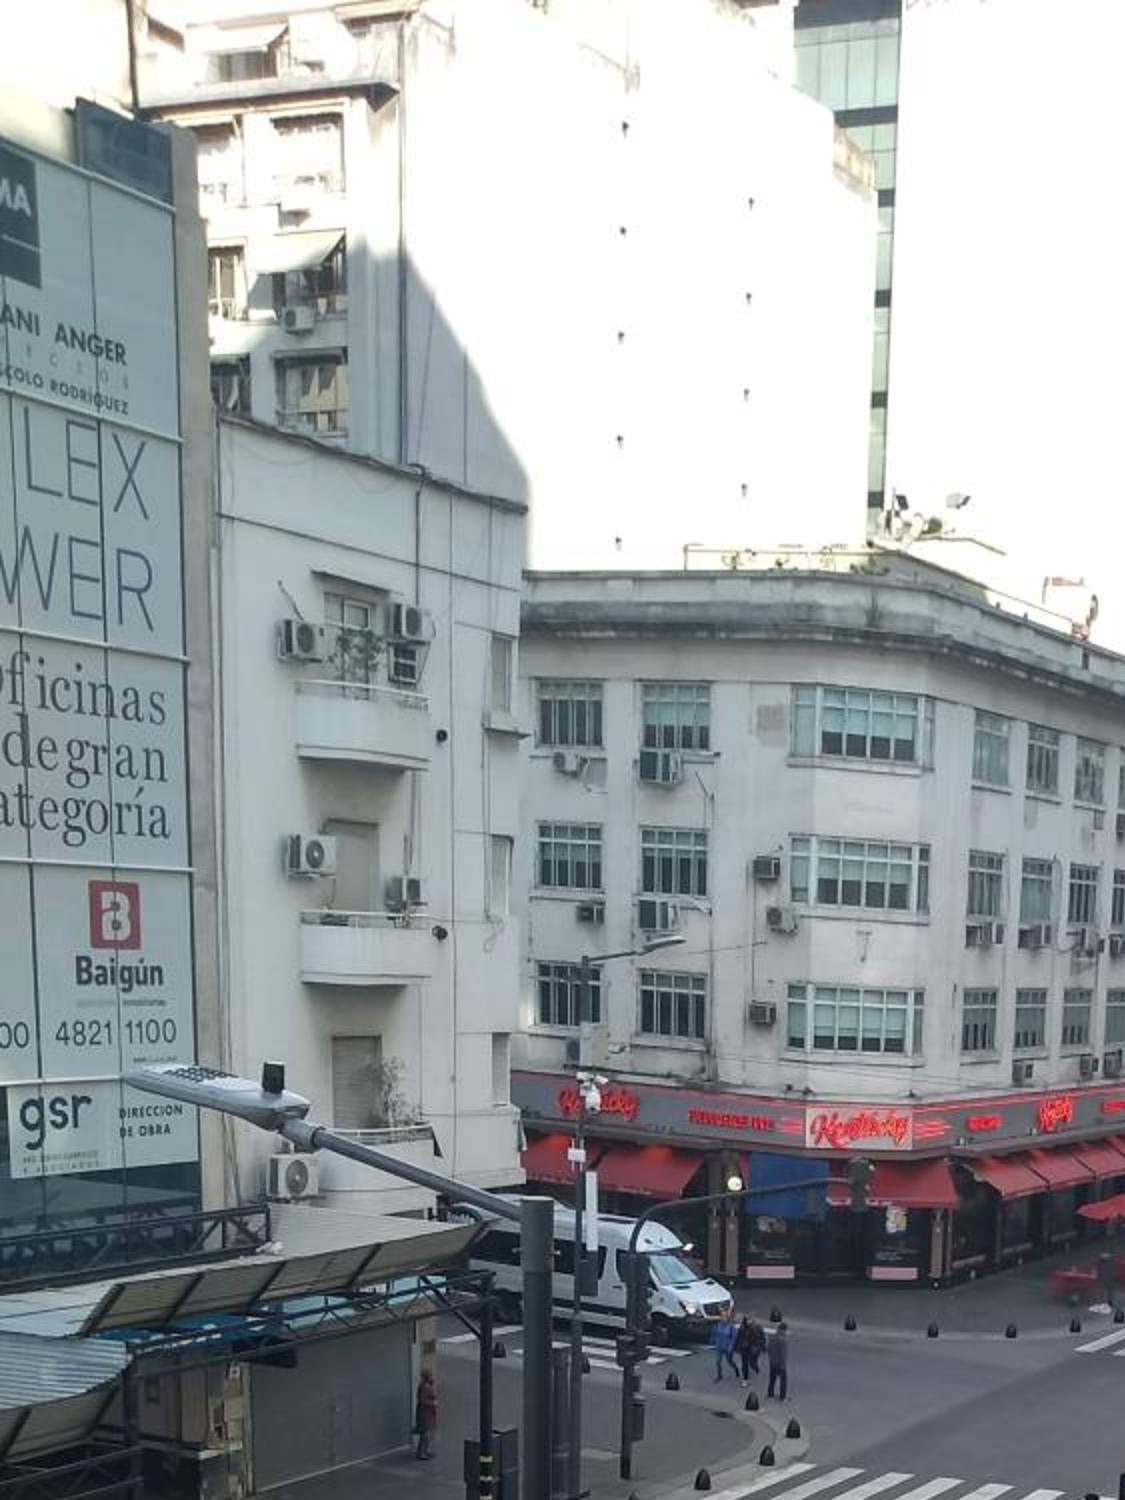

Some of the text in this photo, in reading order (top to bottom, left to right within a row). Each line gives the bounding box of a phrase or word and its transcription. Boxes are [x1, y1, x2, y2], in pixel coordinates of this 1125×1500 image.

[54, 322, 127, 366] ANGER
[0, 360, 43, 388] COLO
[24, 406, 150, 521] LEX
[0, 525, 154, 632] WER
[0, 651, 167, 726] ficinas
[2, 711, 168, 789] de gran
[75, 955, 163, 992] Baigún
[55, 1018, 177, 1046] 4821 1100
[19, 1094, 93, 1150] gsr
[119, 1123, 171, 1138] DE OBRA
